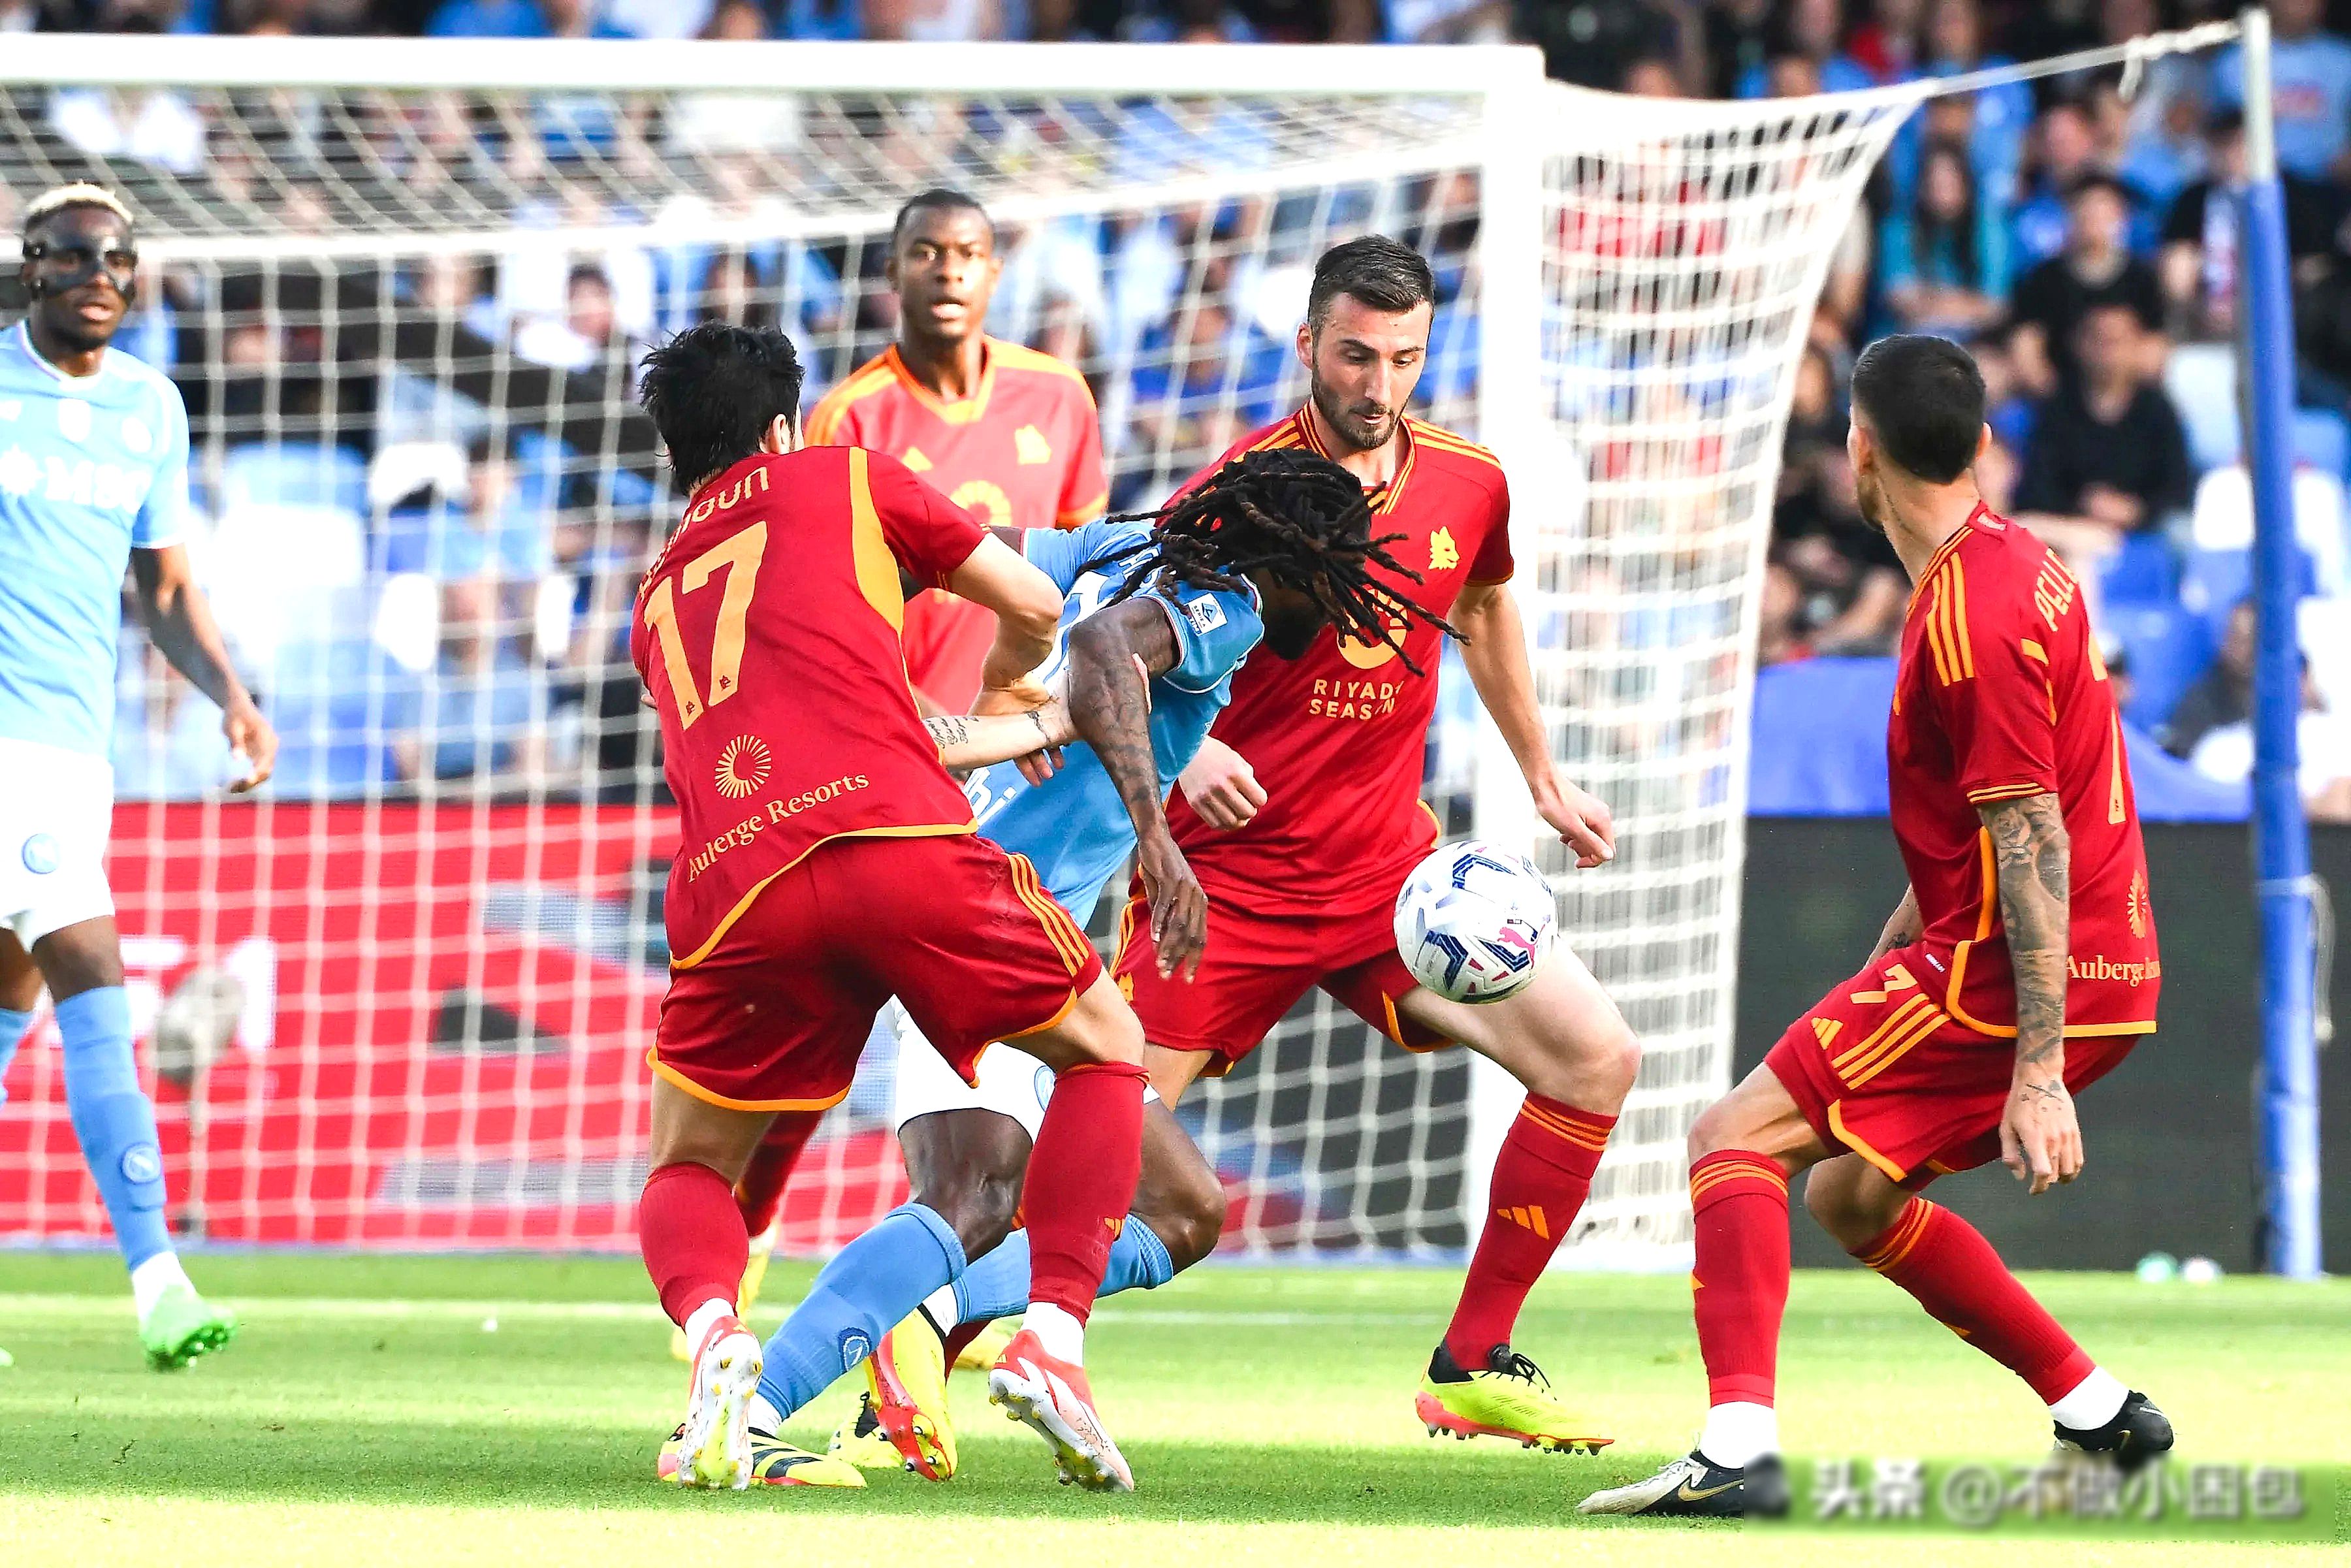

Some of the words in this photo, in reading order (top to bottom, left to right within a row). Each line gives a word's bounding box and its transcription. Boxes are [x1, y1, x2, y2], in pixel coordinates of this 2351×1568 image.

[44, 456, 152, 513] MSC
[643, 520, 769, 731] 17
[1309, 697, 1396, 720] SEASN
[765, 773, 870, 825] Resorts
